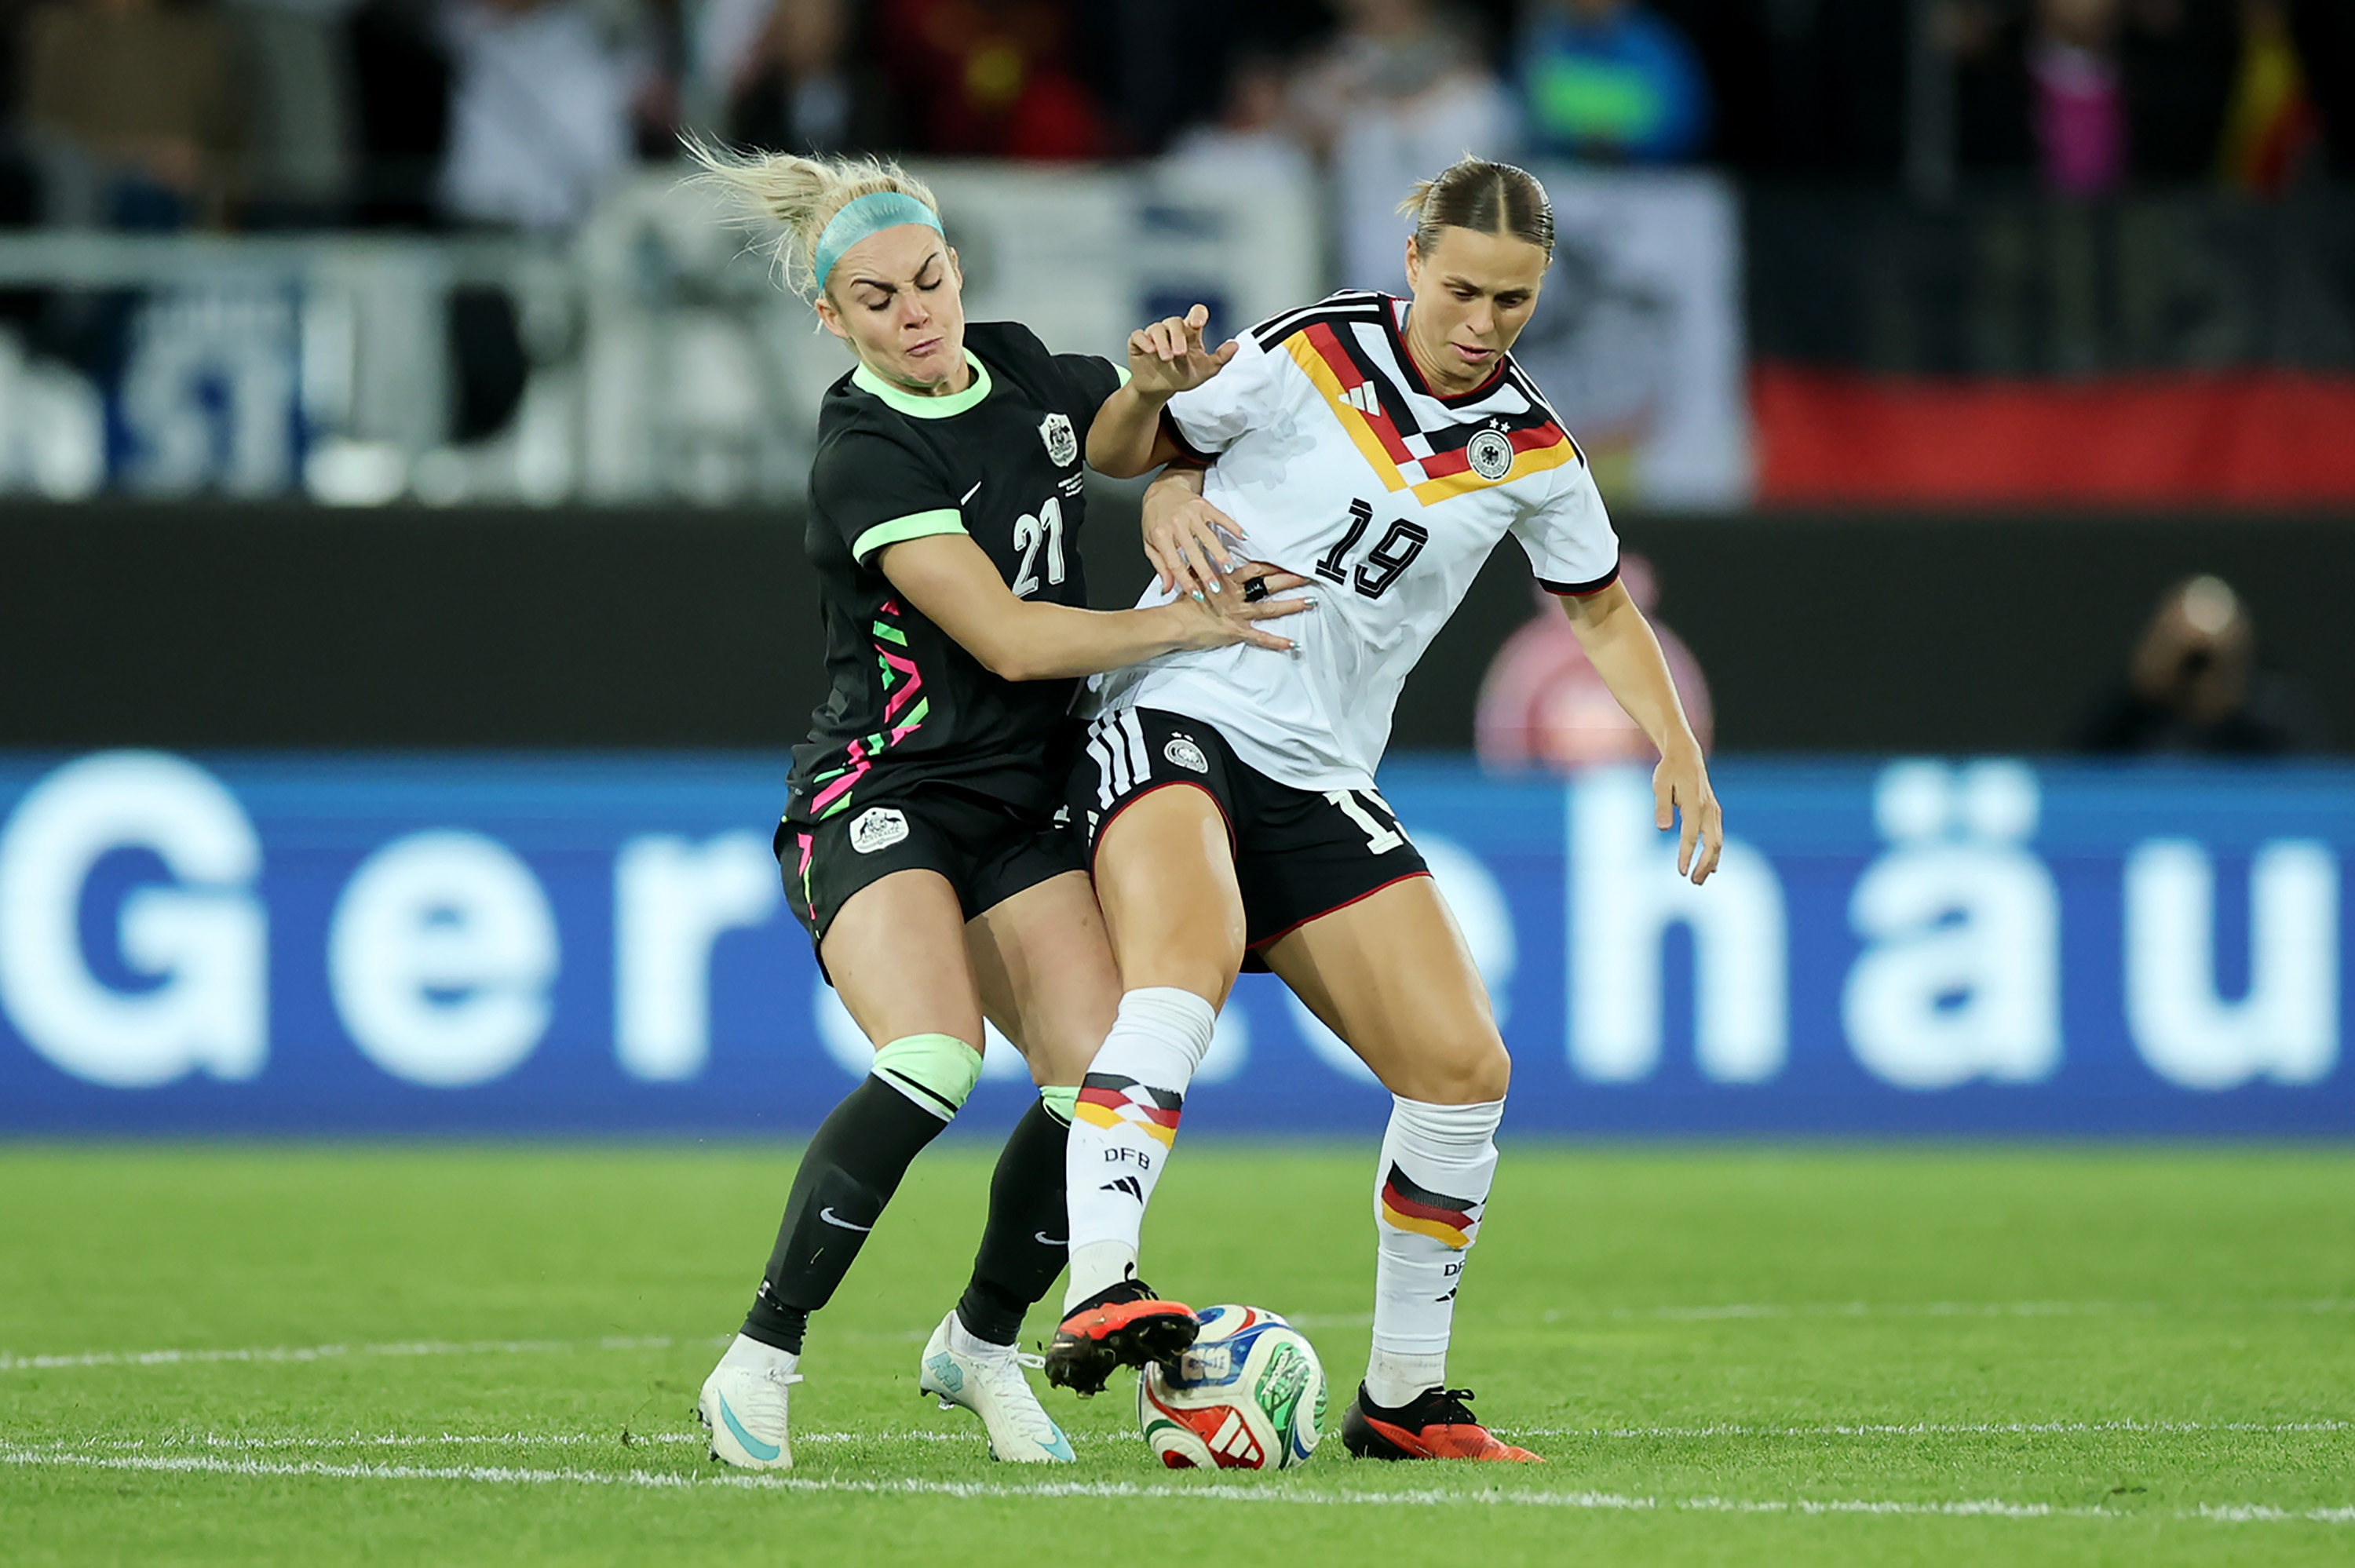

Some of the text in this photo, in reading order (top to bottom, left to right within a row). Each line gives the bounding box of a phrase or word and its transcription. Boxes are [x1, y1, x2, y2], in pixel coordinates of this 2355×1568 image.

[1012, 496, 1065, 598] 21
[1315, 497, 1429, 600] 19
[0, 747, 2341, 1092] Gerhäu
[1104, 1147, 1151, 1171] DFB
